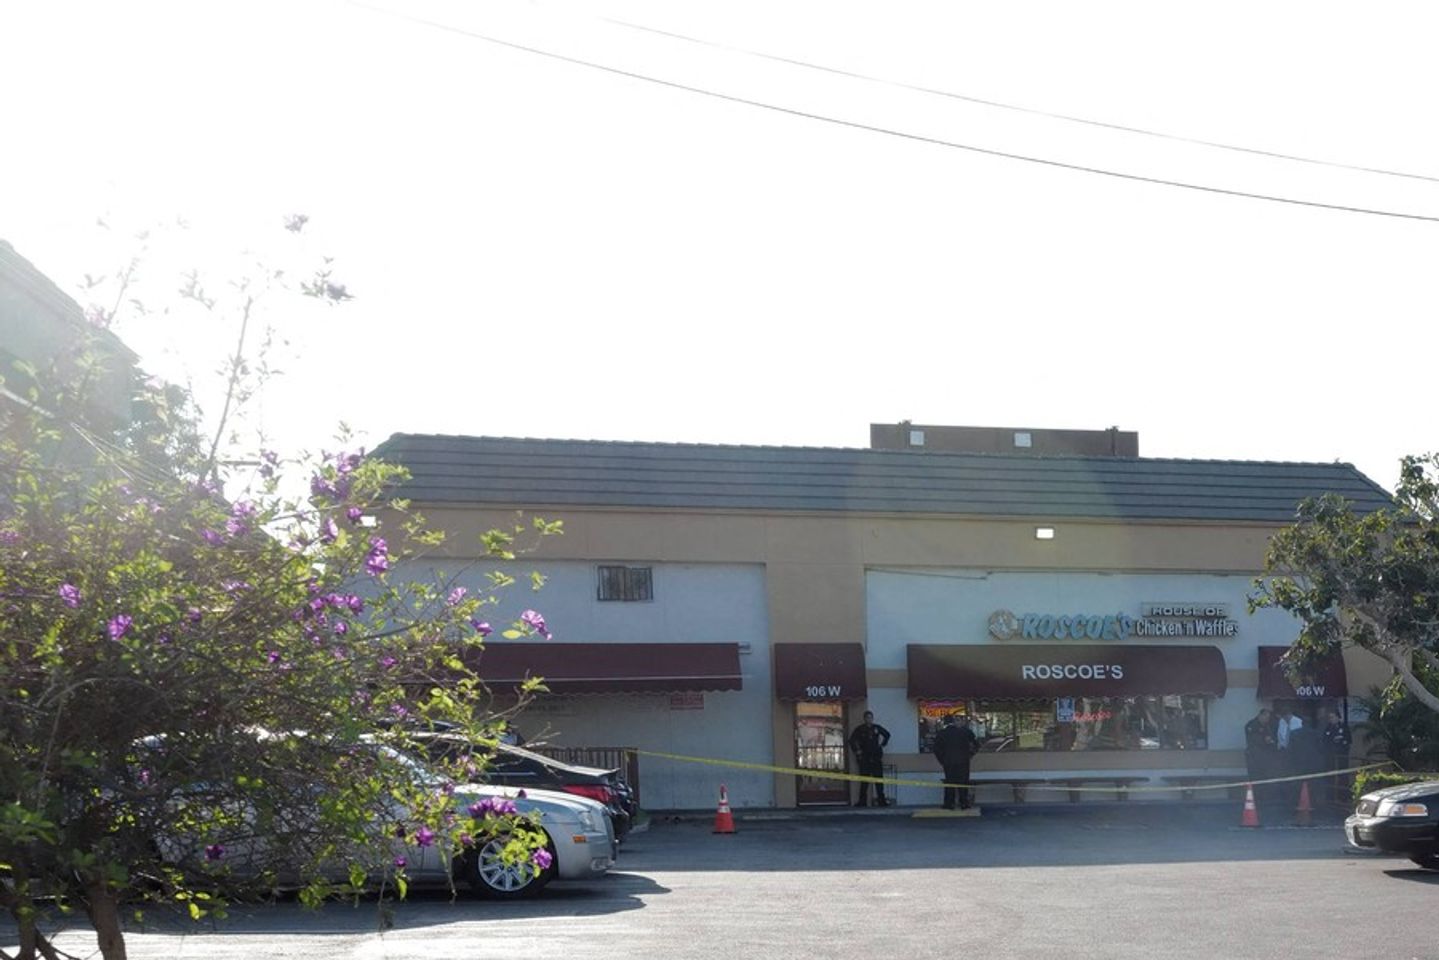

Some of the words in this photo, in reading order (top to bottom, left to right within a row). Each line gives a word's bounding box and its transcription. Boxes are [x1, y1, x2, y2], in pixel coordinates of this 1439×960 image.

[1136, 619, 1183, 636] Chicken
[1195, 619, 1240, 636] Waffles
[1022, 664, 1124, 680] ROSCOE'S
[805, 685, 826, 697] 106
[828, 685, 842, 697] W
[1313, 685, 1326, 697] W
